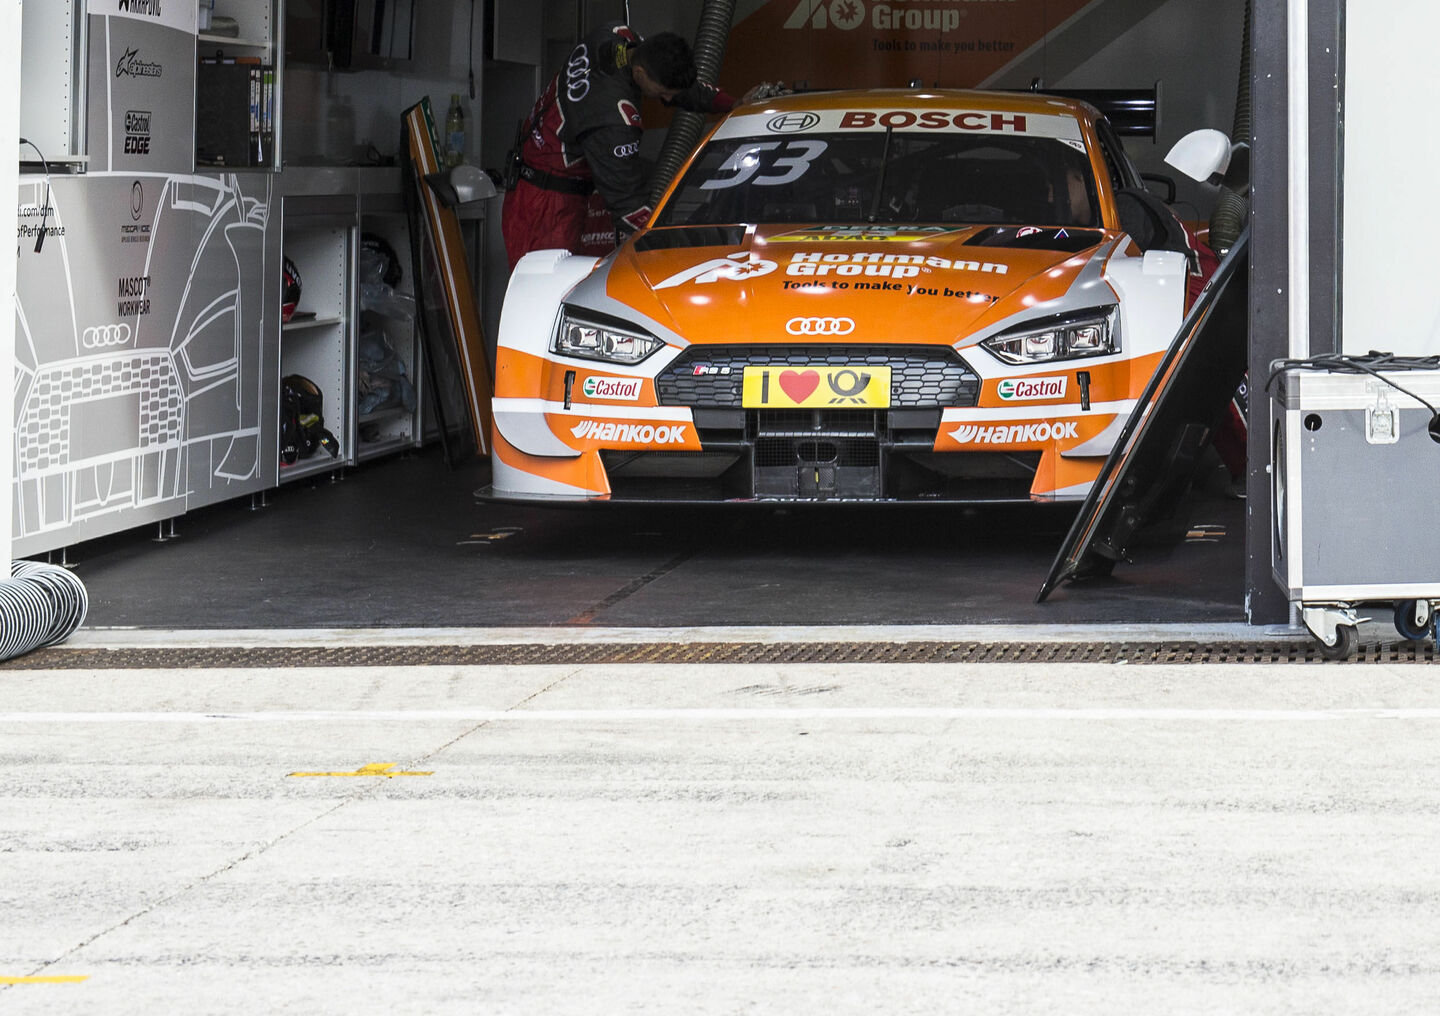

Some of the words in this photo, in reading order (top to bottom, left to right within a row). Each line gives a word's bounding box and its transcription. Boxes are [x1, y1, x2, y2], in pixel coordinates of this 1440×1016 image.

[873, 39, 901, 52] Tools
[904, 40, 917, 52] to
[920, 40, 952, 52] make
[954, 41, 976, 54] you
[978, 40, 1016, 52] better
[839, 110, 1027, 133] BOSCH
[124, 136, 151, 154] EDGE
[701, 139, 829, 190] 53
[789, 252, 1009, 275] Hoffmann
[782, 280, 827, 290] Tools
[832, 280, 850, 290] to
[854, 280, 903, 291] make
[907, 283, 938, 296] you
[943, 287, 1001, 303] better
[117, 299, 151, 317] WORKWEAR
[595, 379, 638, 398] Castrol
[1014, 379, 1063, 398] Castrol
